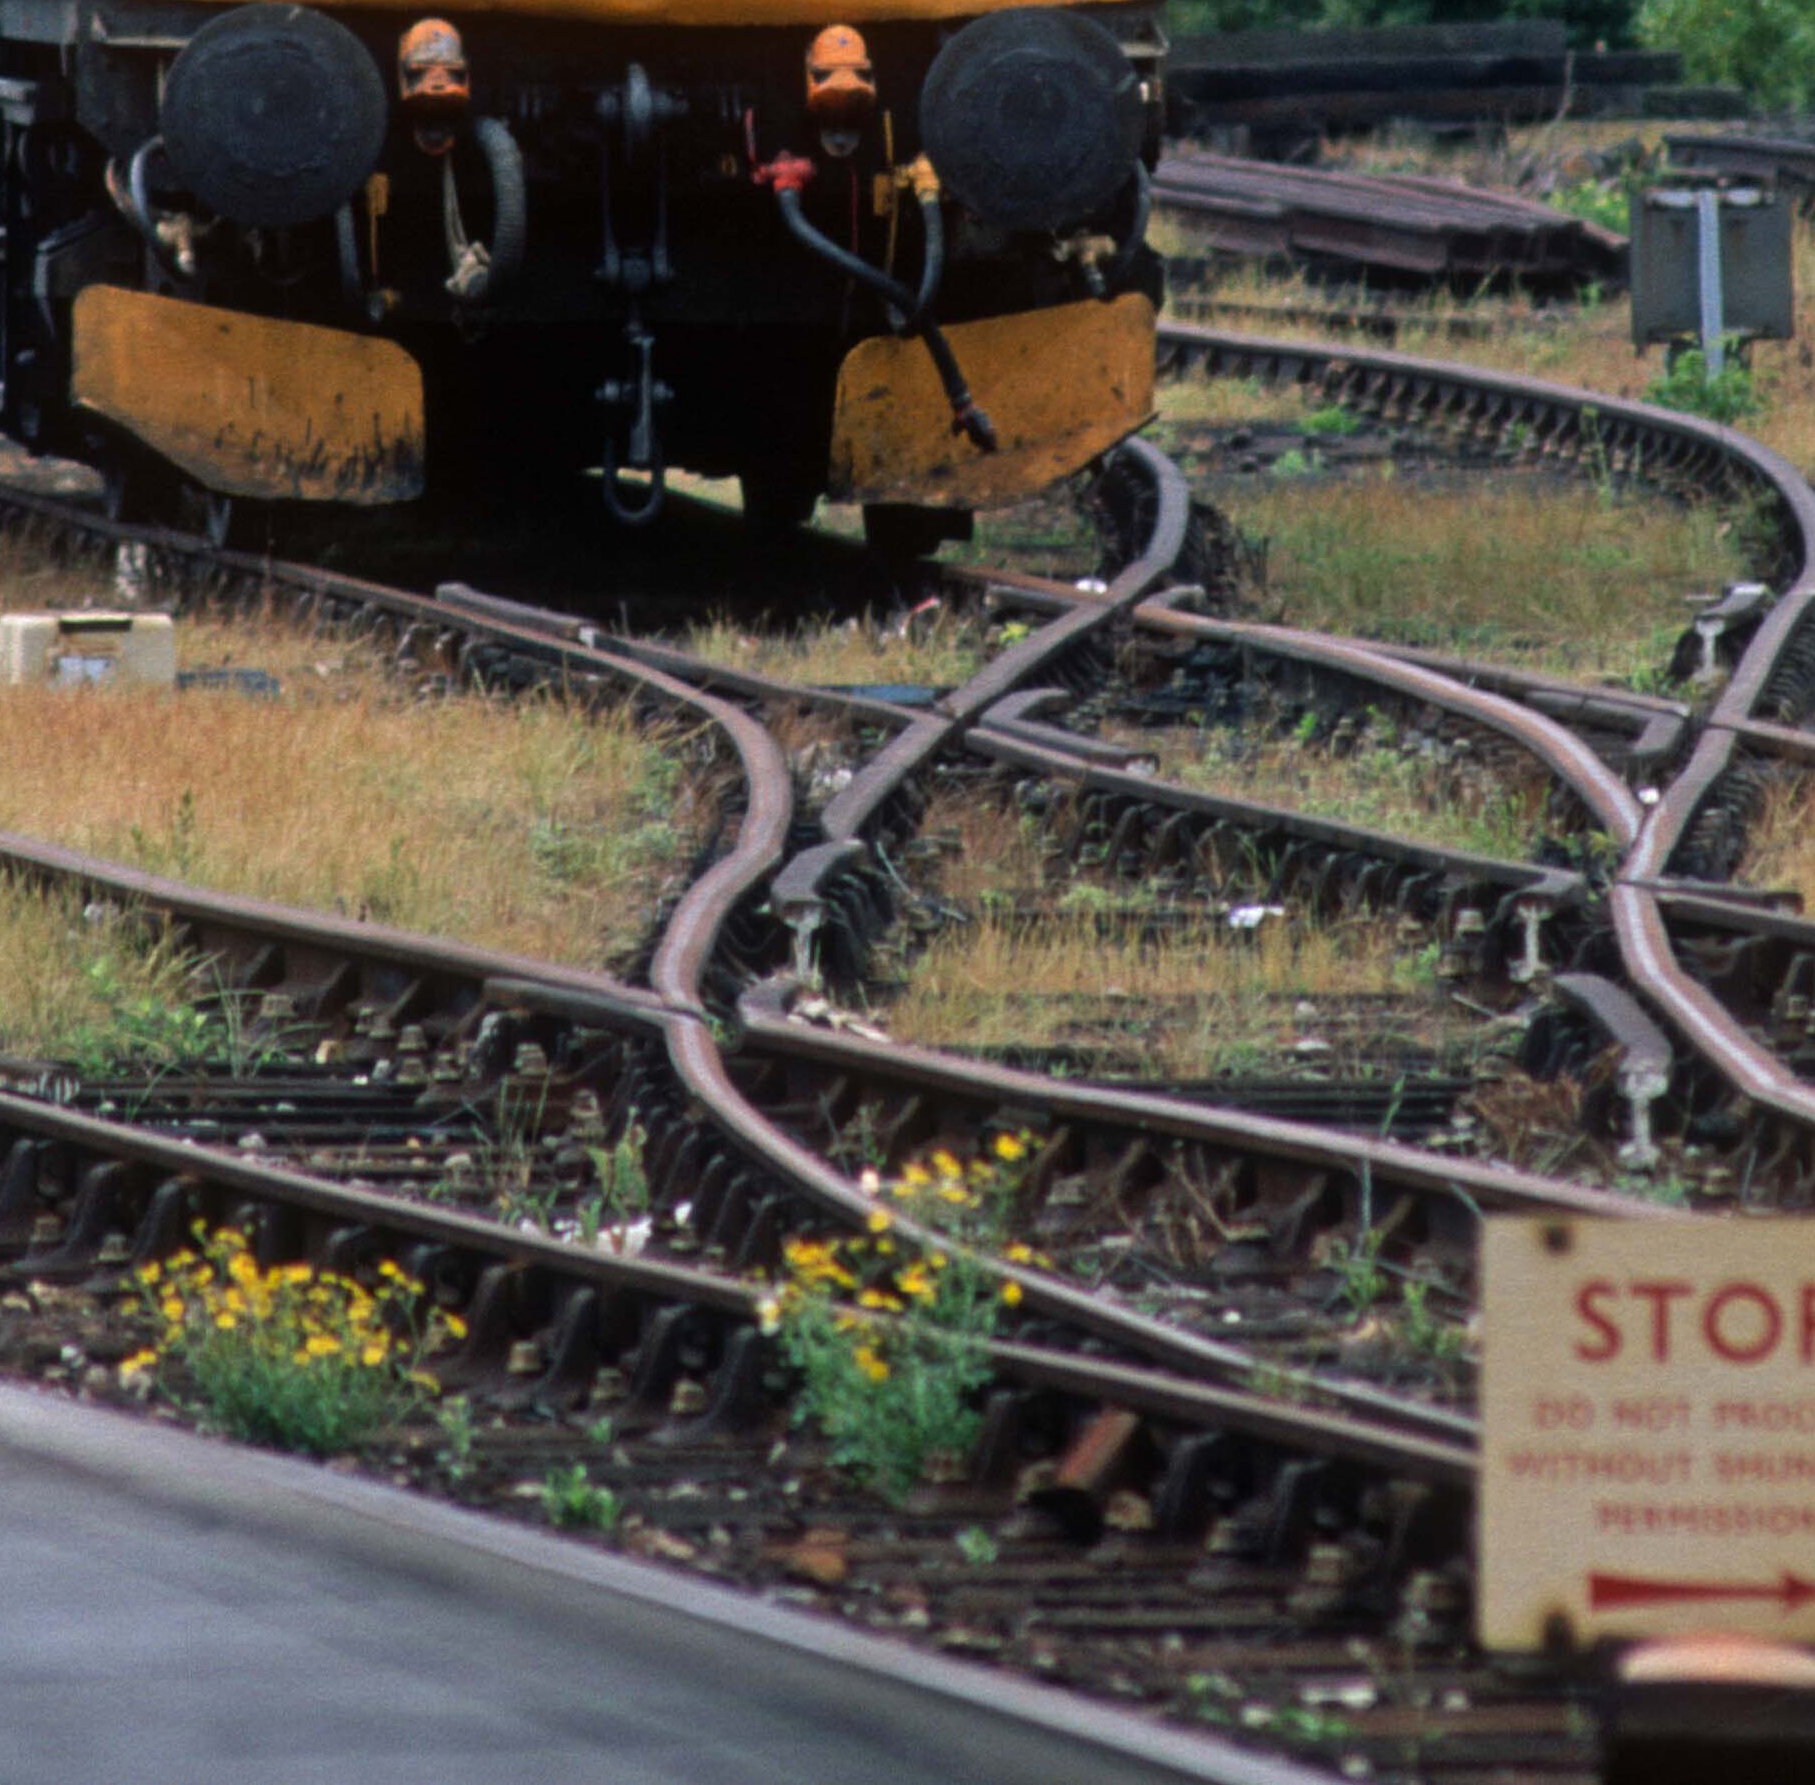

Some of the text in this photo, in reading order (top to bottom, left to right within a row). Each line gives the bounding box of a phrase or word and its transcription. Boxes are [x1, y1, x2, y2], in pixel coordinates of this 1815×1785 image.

[1536, 1399, 1593, 1431] DO
[1614, 1399, 1689, 1431] NOT
[1507, 1451, 1690, 1484] WITHOUT
